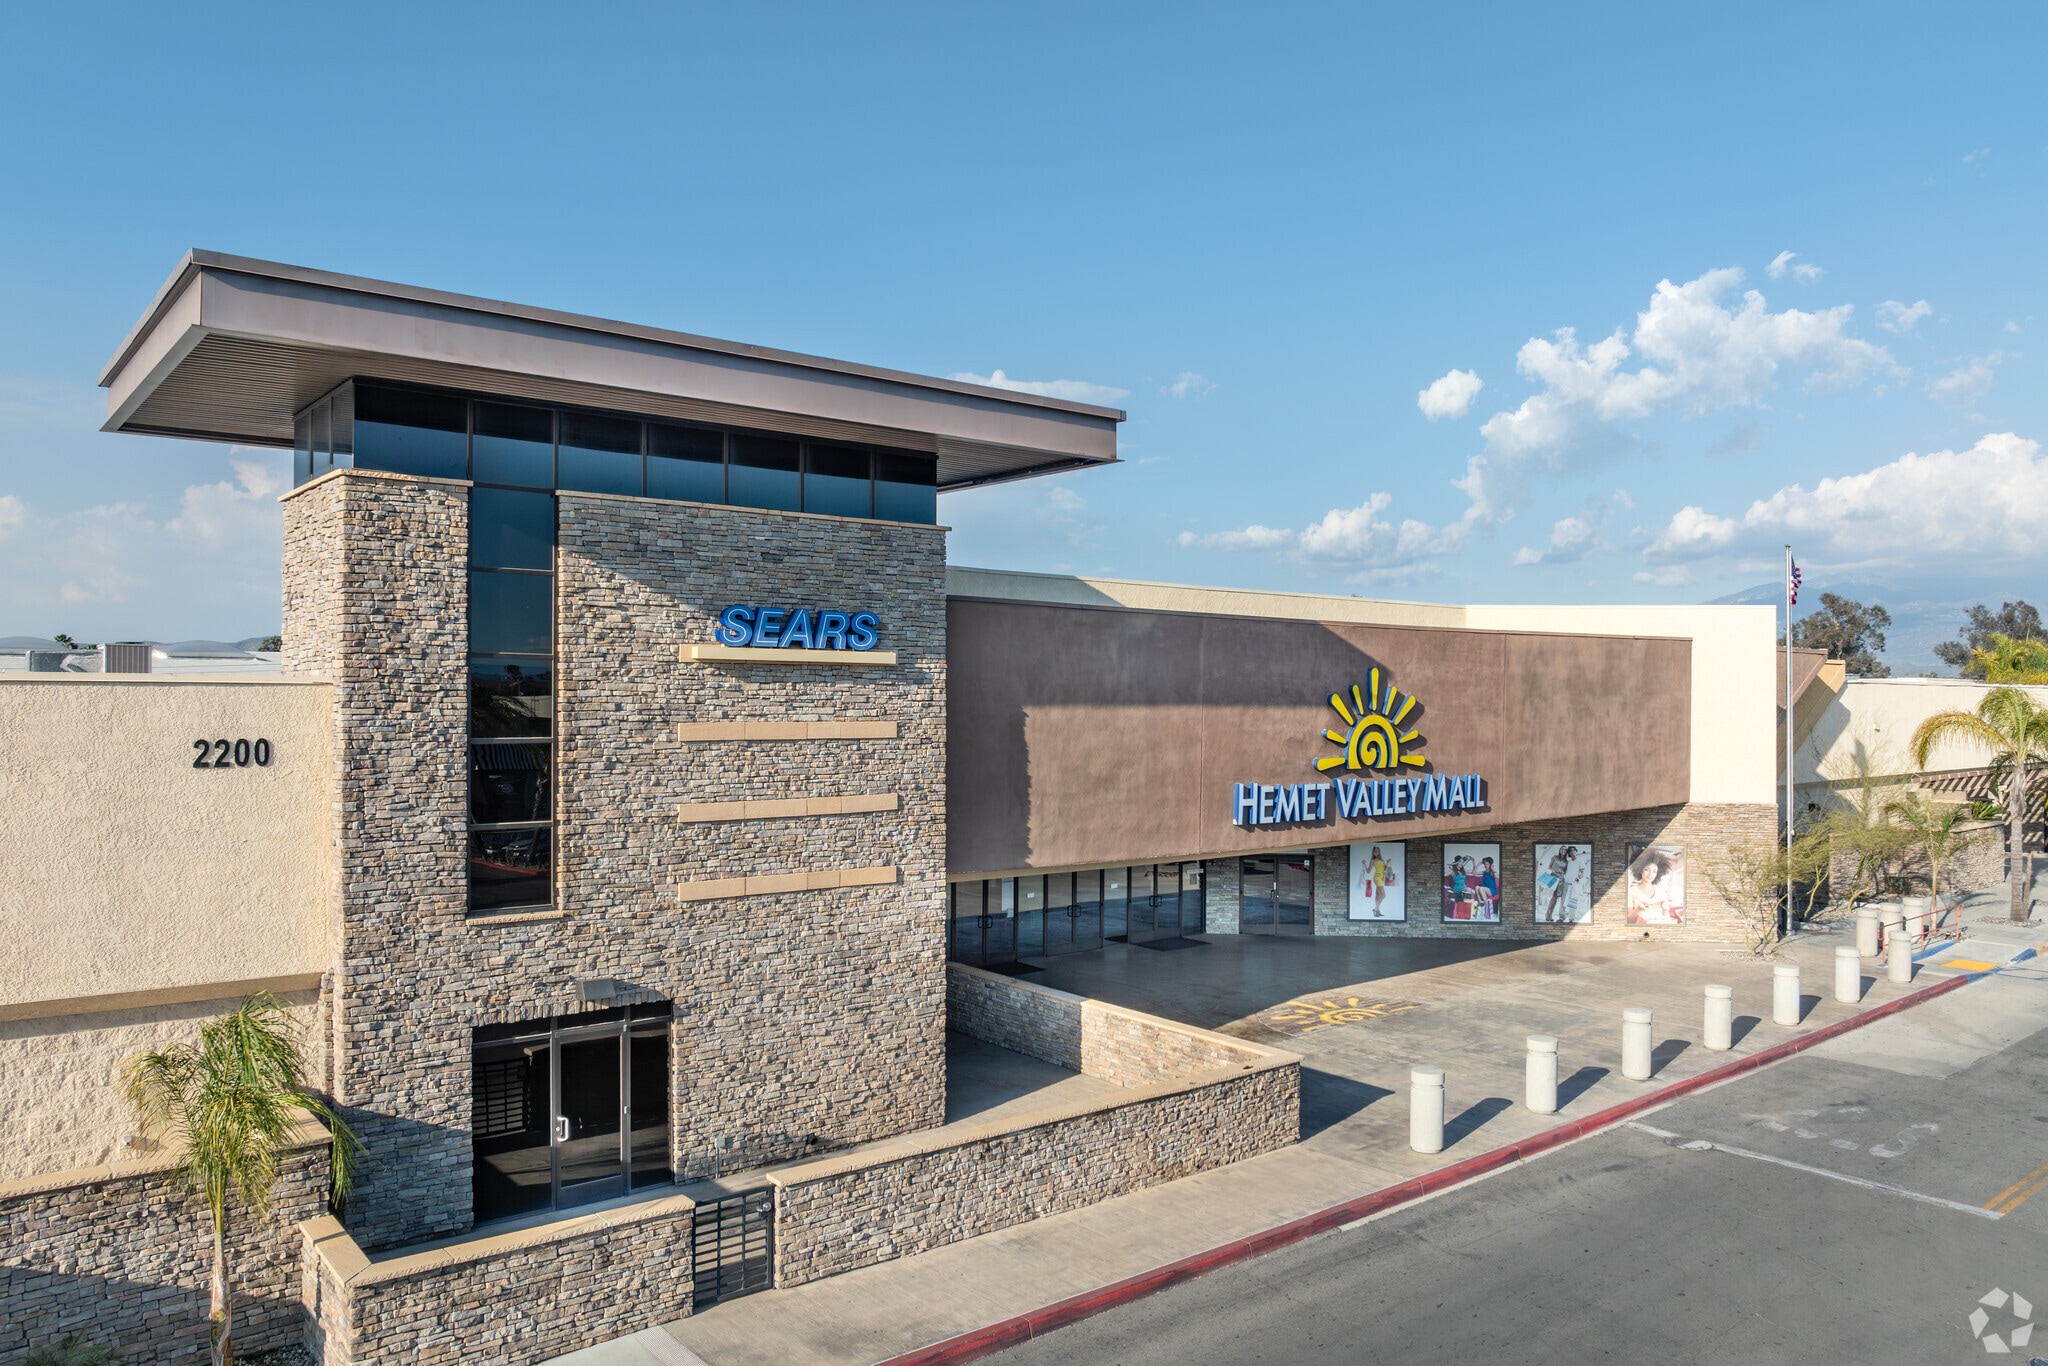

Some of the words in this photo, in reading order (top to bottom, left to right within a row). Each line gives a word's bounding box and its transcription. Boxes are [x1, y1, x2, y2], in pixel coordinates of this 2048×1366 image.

[715, 605, 880, 650] SEARS
[193, 738, 270, 768] 2200
[1233, 782, 1330, 826] HEMET
[1333, 777, 1422, 819] VALLEY
[1422, 773, 1485, 812] MALL
